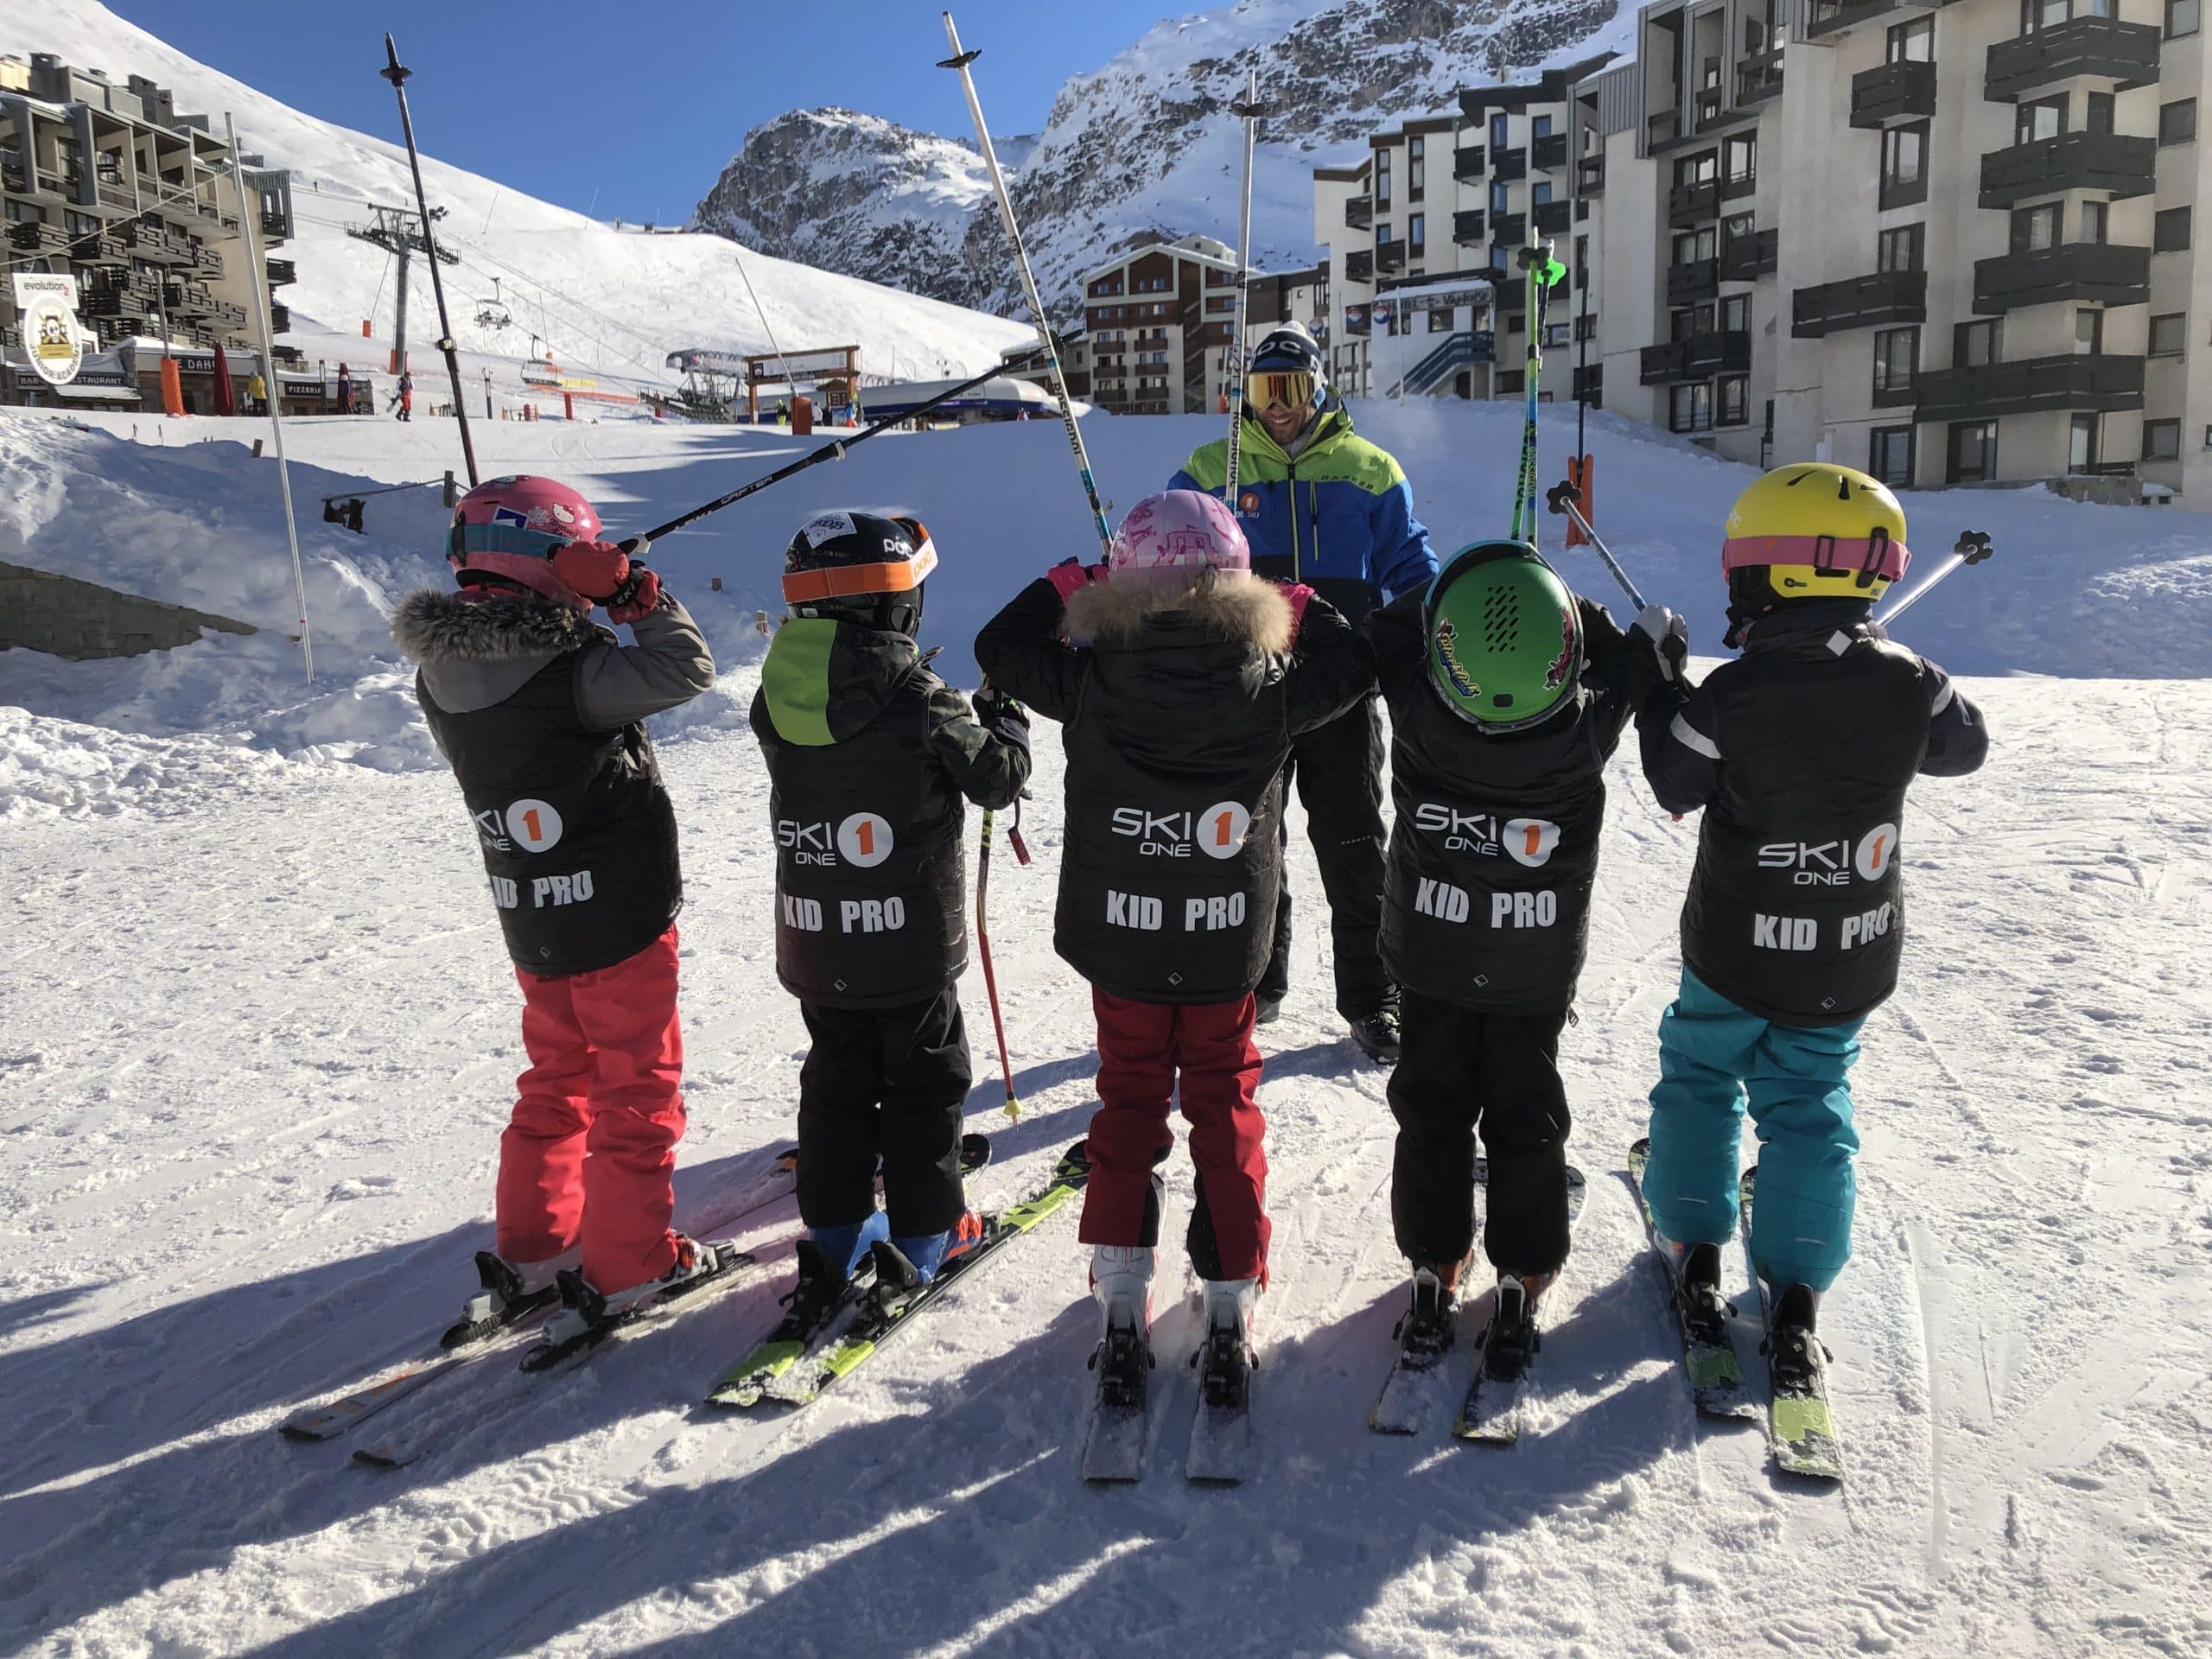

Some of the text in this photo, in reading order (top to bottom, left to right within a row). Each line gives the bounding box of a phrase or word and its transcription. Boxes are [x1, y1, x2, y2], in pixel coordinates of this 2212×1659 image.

[30, 342, 80, 380] JUNIOR ACADEMY
[523, 809, 543, 842] 1
[779, 820, 874, 855] SKI 1
[1112, 807, 1233, 846] SKI 1
[1415, 803, 1541, 856] SKI 1
[795, 851, 837, 867] ONE
[1140, 842, 1192, 858] ONE
[1445, 836, 1499, 857] ONE
[1758, 834, 1887, 871] SKI 1
[492, 869, 594, 909] ID PRO
[1794, 870, 1851, 886] ONE
[783, 893, 906, 933] KID PRO
[1106, 889, 1246, 931] KID PRO
[1414, 876, 1557, 929] KID PRO
[1754, 901, 1891, 951] KID PRO
